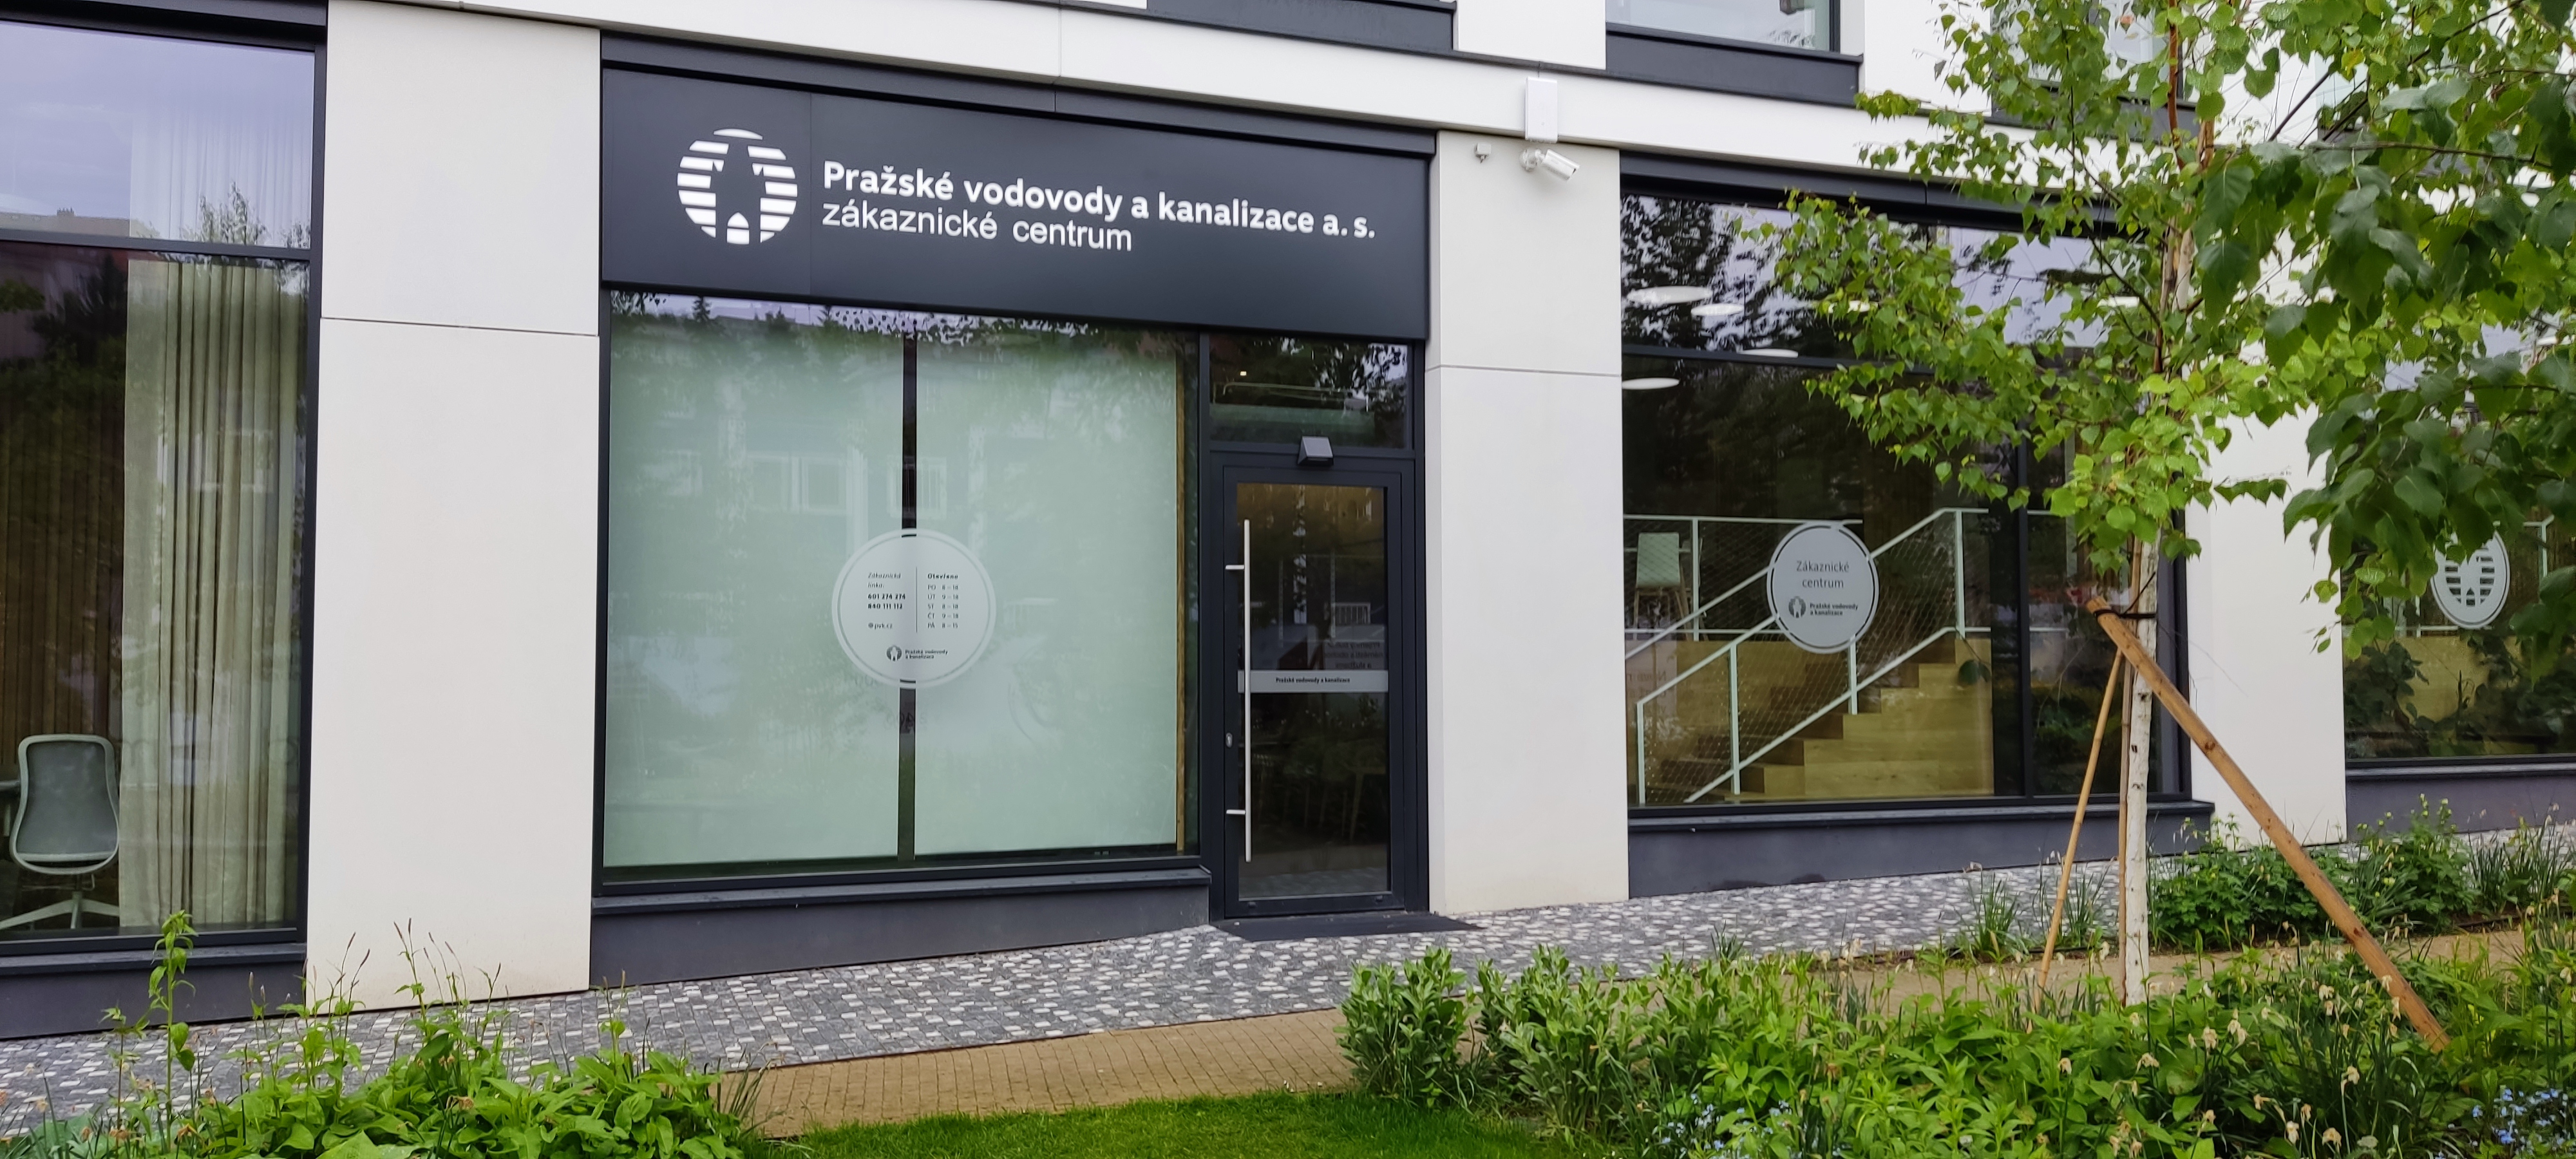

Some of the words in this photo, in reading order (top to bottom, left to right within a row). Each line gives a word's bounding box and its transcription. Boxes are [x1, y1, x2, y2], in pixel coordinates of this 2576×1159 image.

[824, 160, 954, 201] Pražské
[963, 178, 1123, 222] vodovody
[1131, 195, 1150, 219] a
[1159, 191, 1314, 234] kanalizace
[1322, 213, 1348, 236] a.
[1353, 216, 1376, 239] s.
[822, 198, 998, 240] zákaznické
[1012, 220, 1132, 251] centrum
[1796, 560, 1850, 573] Zákaznické
[1802, 578, 1844, 589] centrum
